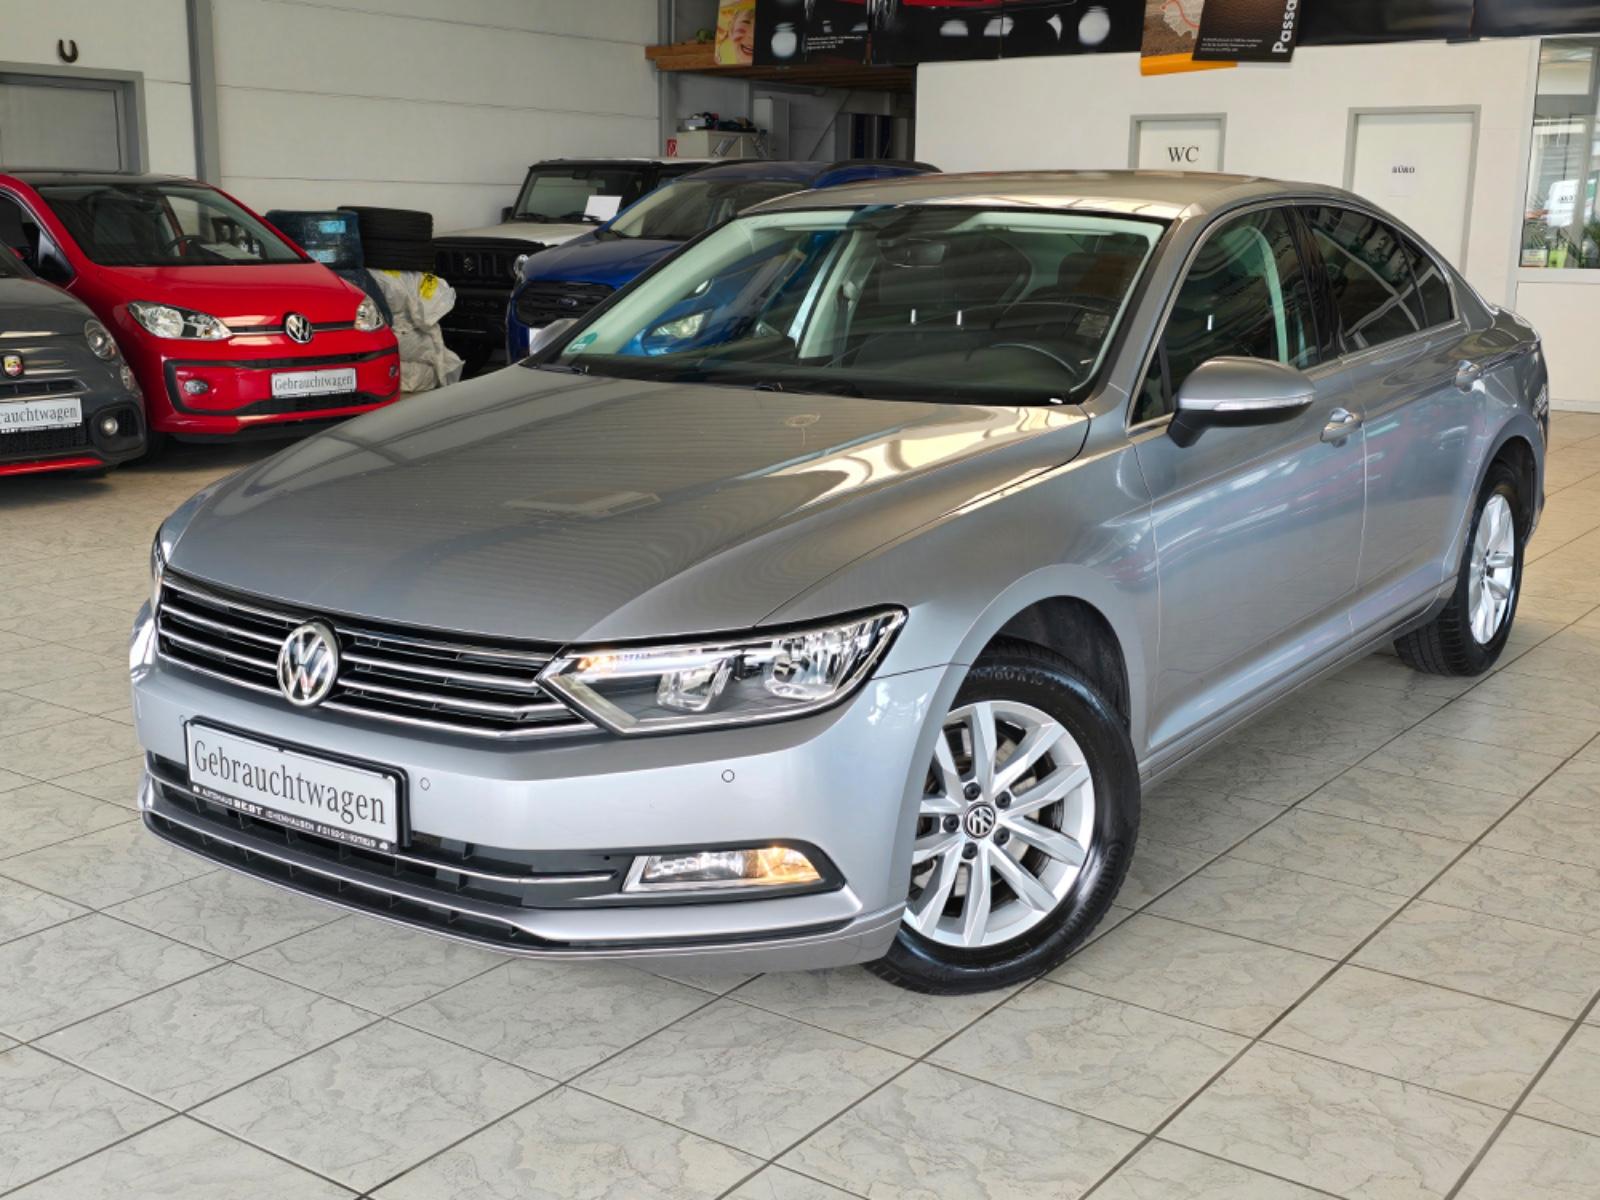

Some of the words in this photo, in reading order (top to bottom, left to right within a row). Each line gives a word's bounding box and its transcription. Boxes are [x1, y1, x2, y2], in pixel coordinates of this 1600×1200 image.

[1168, 146, 1199, 163] WC
[1391, 164, 1416, 174] BÜRO
[274, 375, 353, 391] Gebrauchtwagen
[193, 739, 386, 825] Gebrauchtwagen
